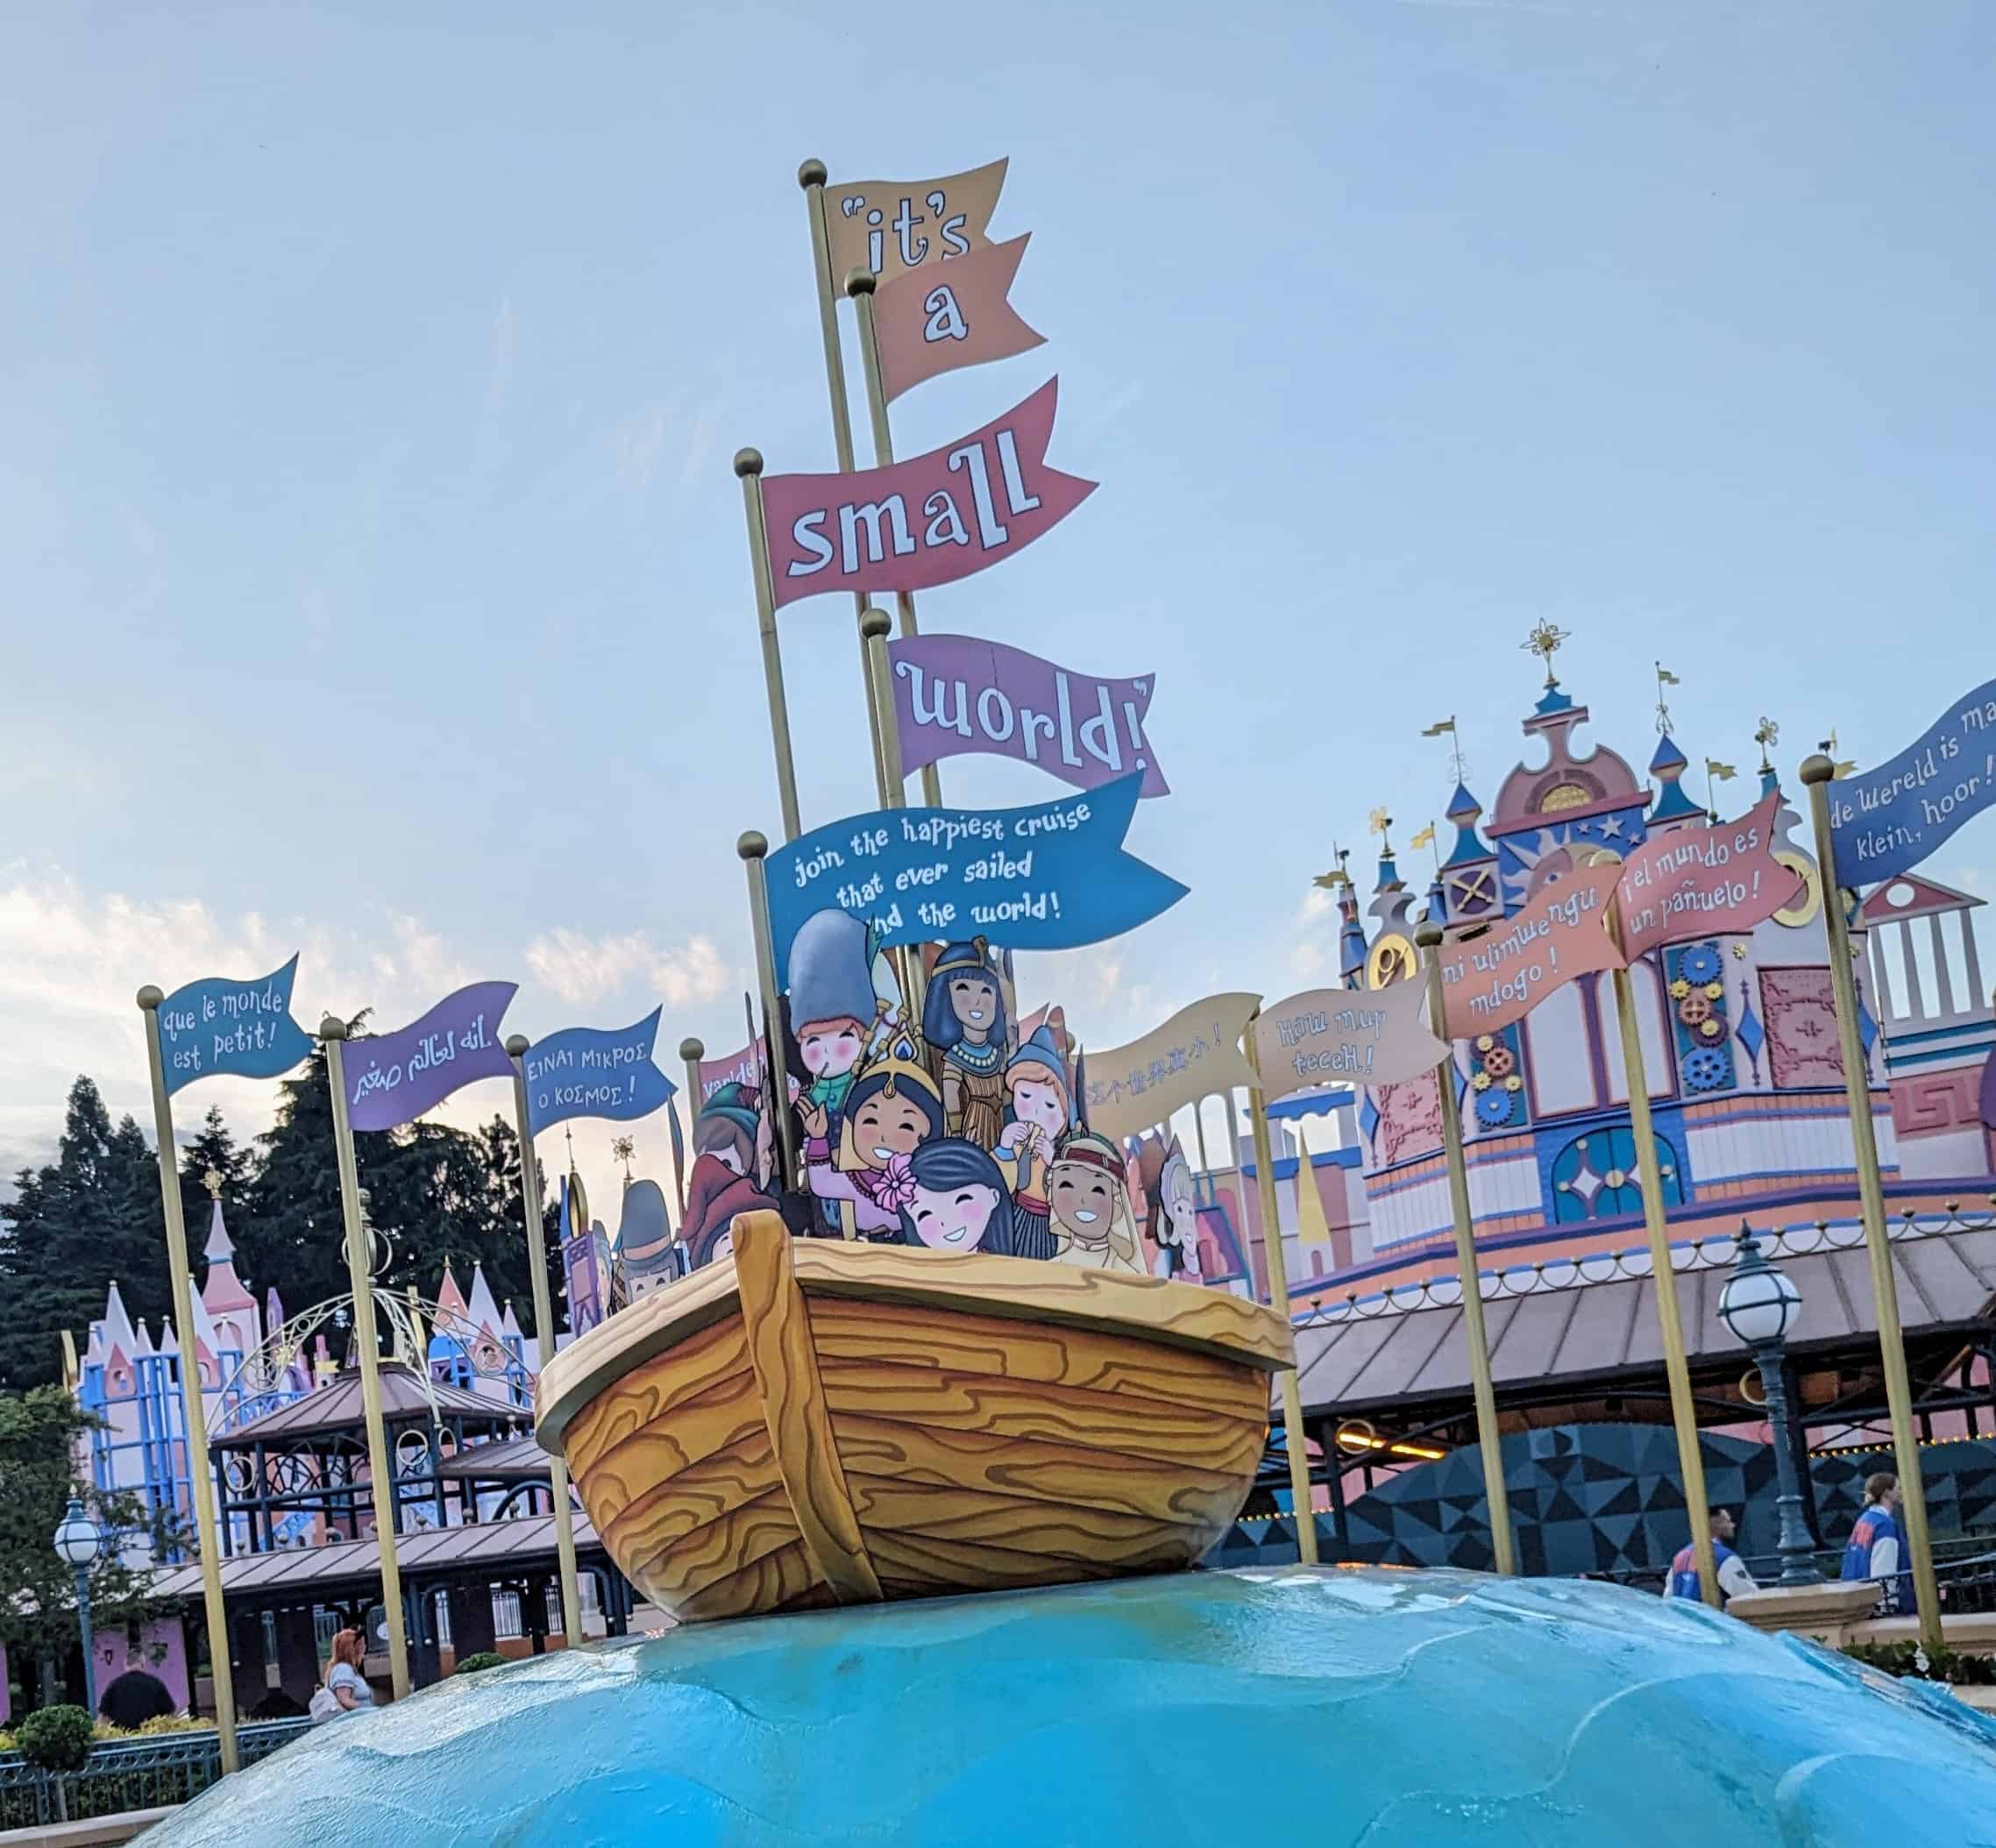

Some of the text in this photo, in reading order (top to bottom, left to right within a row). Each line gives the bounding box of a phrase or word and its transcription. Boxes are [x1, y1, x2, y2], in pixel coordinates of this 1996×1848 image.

[924, 284, 969, 343] a
[786, 428, 1041, 578] small
[1830, 800, 1853, 828] de
[1940, 735, 1959, 759] is
[795, 803, 1091, 887] join the happiest cruise
[1656, 835, 1729, 878] mundo
[1735, 827, 1758, 853] es
[836, 850, 1034, 908] that ever sailed
[919, 902, 956, 928] the
[970, 892, 1061, 924] world!
[1443, 887, 1598, 983] ni ulimwengu
[1630, 909, 1655, 934] un
[164, 981, 282, 1041] que le monde
[174, 1020, 276, 1070] est petit!
[352, 1060, 401, 1105] صغير
